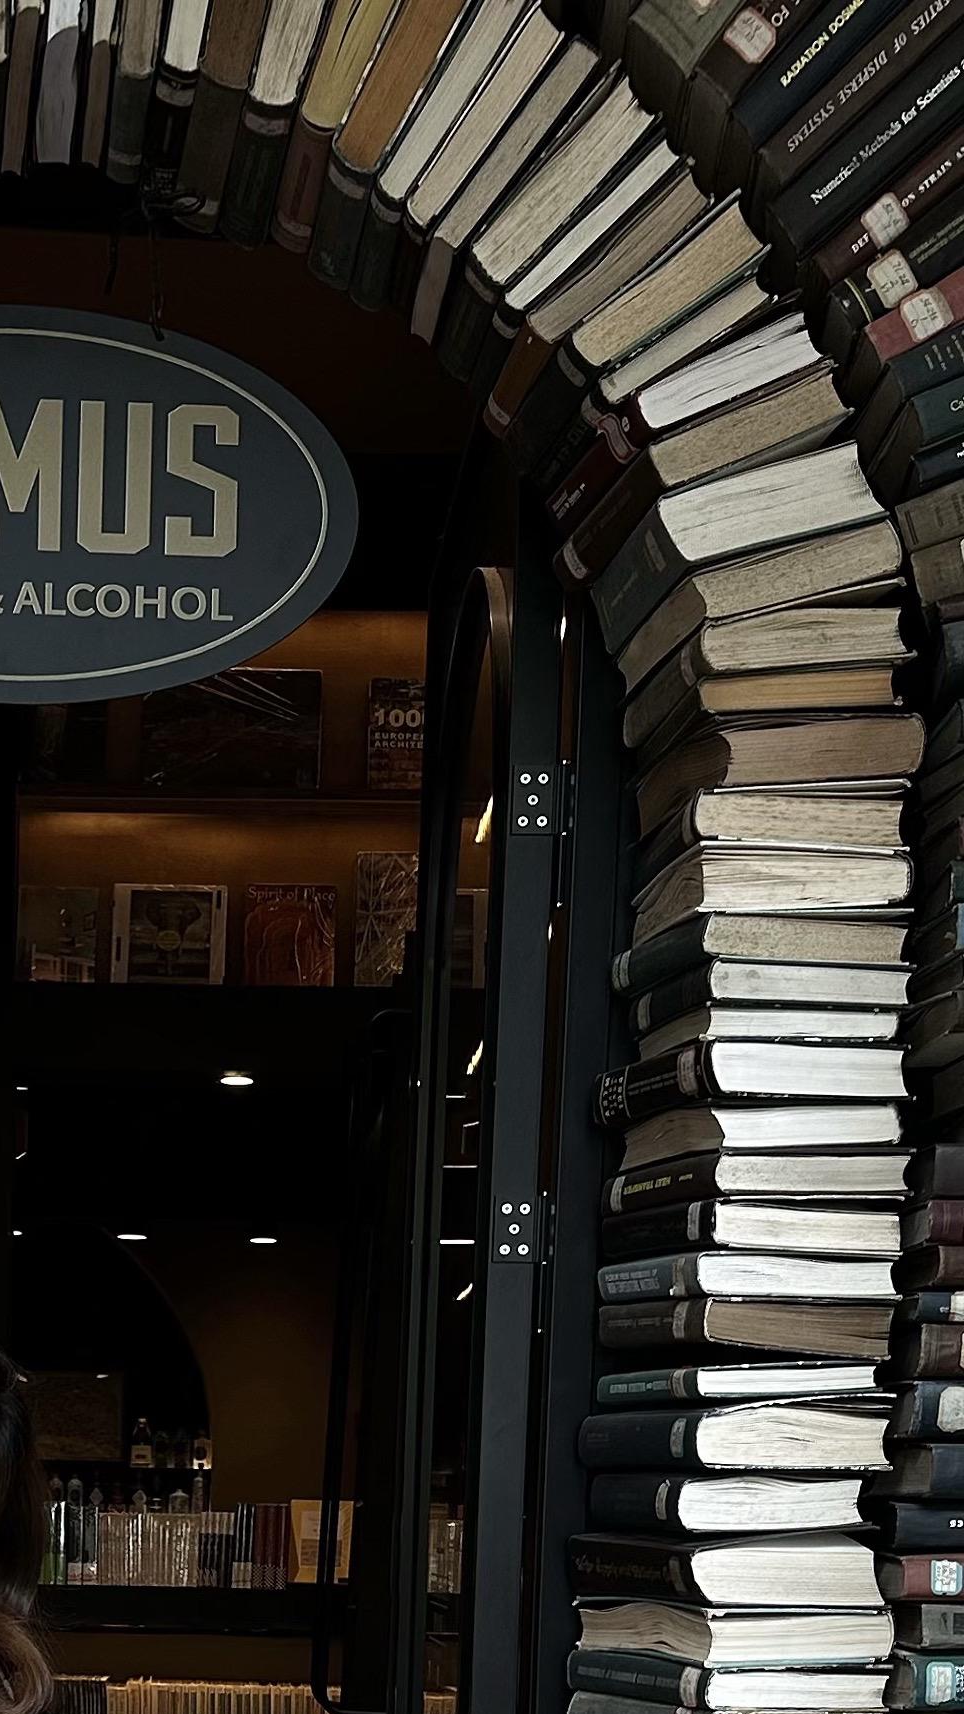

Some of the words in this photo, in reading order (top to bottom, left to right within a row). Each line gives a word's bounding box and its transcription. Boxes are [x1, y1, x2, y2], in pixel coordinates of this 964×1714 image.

[779, 31, 830, 88] RADIATION
[893, 31, 908, 54] OF
[837, 50, 888, 106] DISPERSE
[786, 100, 836, 153] SYSTEMS
[809, 156, 861, 205] Numerical
[859, 120, 902, 162] Methods
[900, 106, 918, 126] for
[916, 66, 961, 110] Scientists
[917, 159, 953, 194] STRAIN
[12, 581, 234, 622] ALCOHOL
[247, 887, 285, 902] Spirit
[287, 886, 300, 901] of
[303, 886, 337, 902] Place
